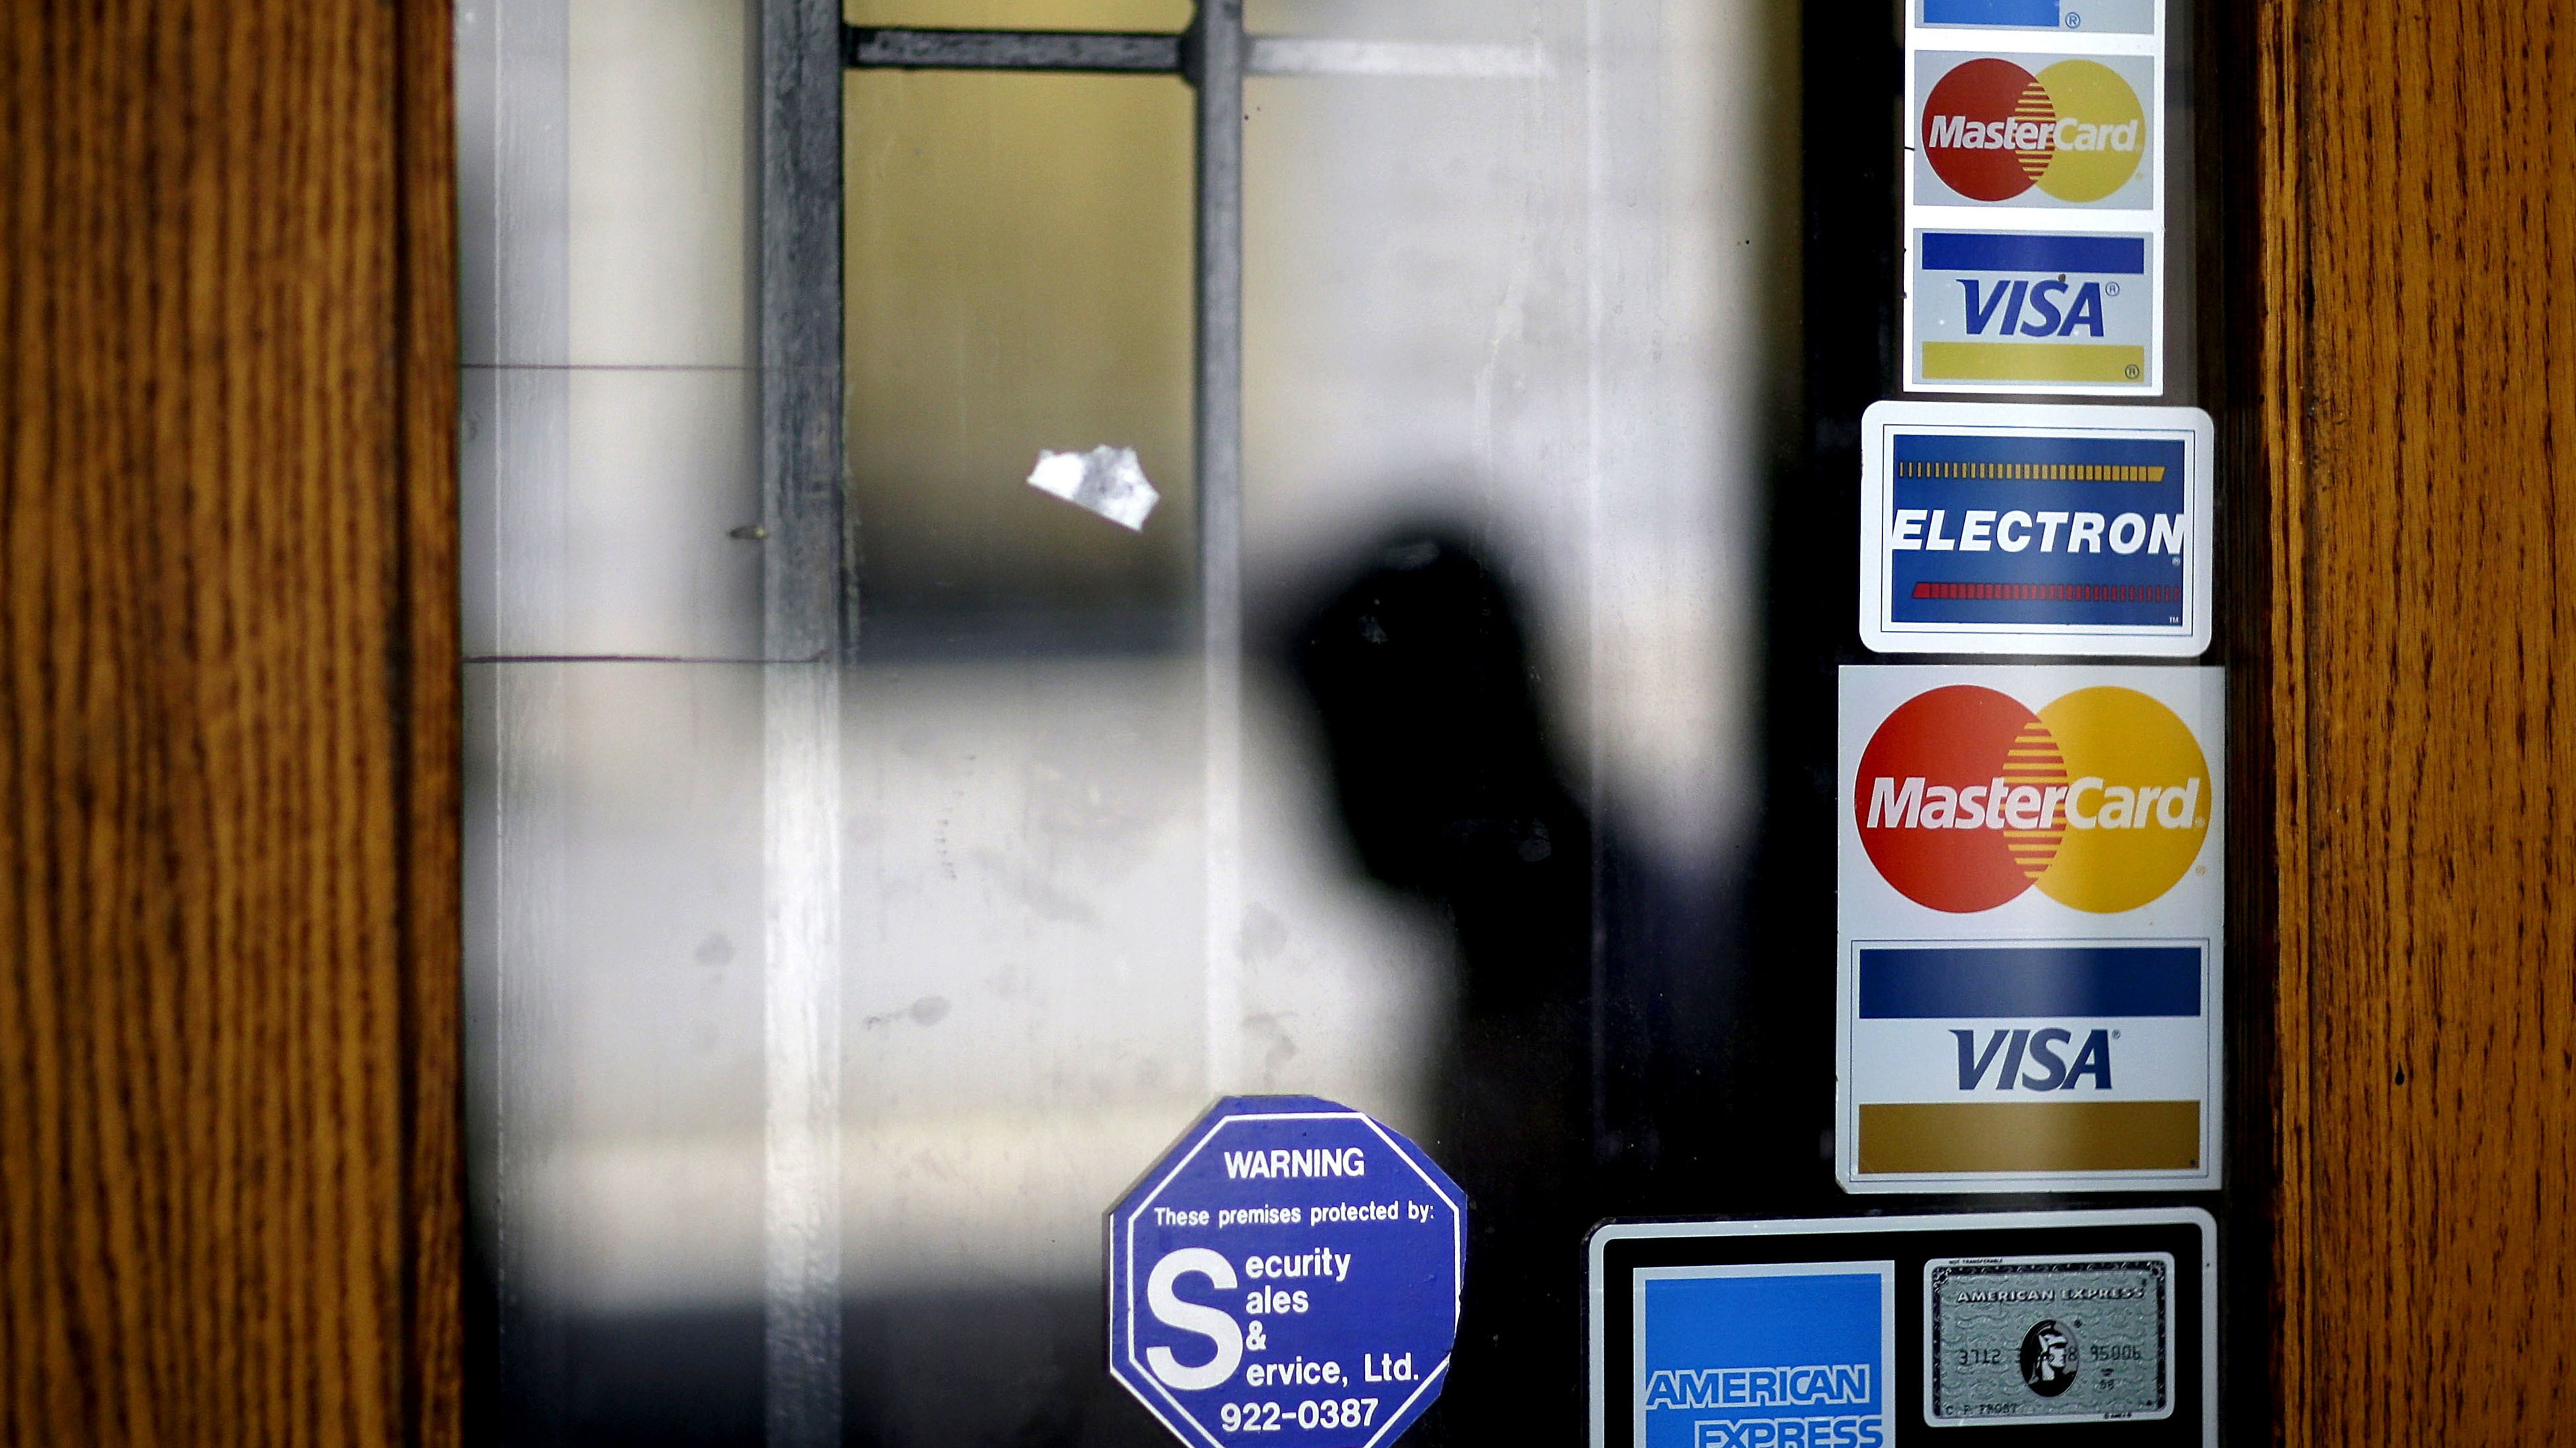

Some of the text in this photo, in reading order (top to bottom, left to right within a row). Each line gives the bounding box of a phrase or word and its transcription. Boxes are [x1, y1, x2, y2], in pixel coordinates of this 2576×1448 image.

[1928, 115, 2139, 152] MasterCard
[1956, 278, 2105, 337] VISA
[1891, 508, 2186, 555] ELECTRON
[1866, 776, 2201, 829] MasterCard
[1948, 1028, 2113, 1091] VISA
[1224, 1147, 1365, 1179] WARNING
[1154, 1200, 1434, 1228] These premises protected by:
[1956, 1287, 2146, 1304] AMERICAN EXPRESS
[1364, 1352, 1419, 1383] Ltd.
[1959, 1349, 2001, 1365] 3712
[2089, 1344, 2142, 1361] 95006
[1645, 1364, 1871, 1410] AMERICAN
[1220, 1398, 1379, 1433] 922-0387
[1694, 1414, 1884, 1448] EXPRESS
